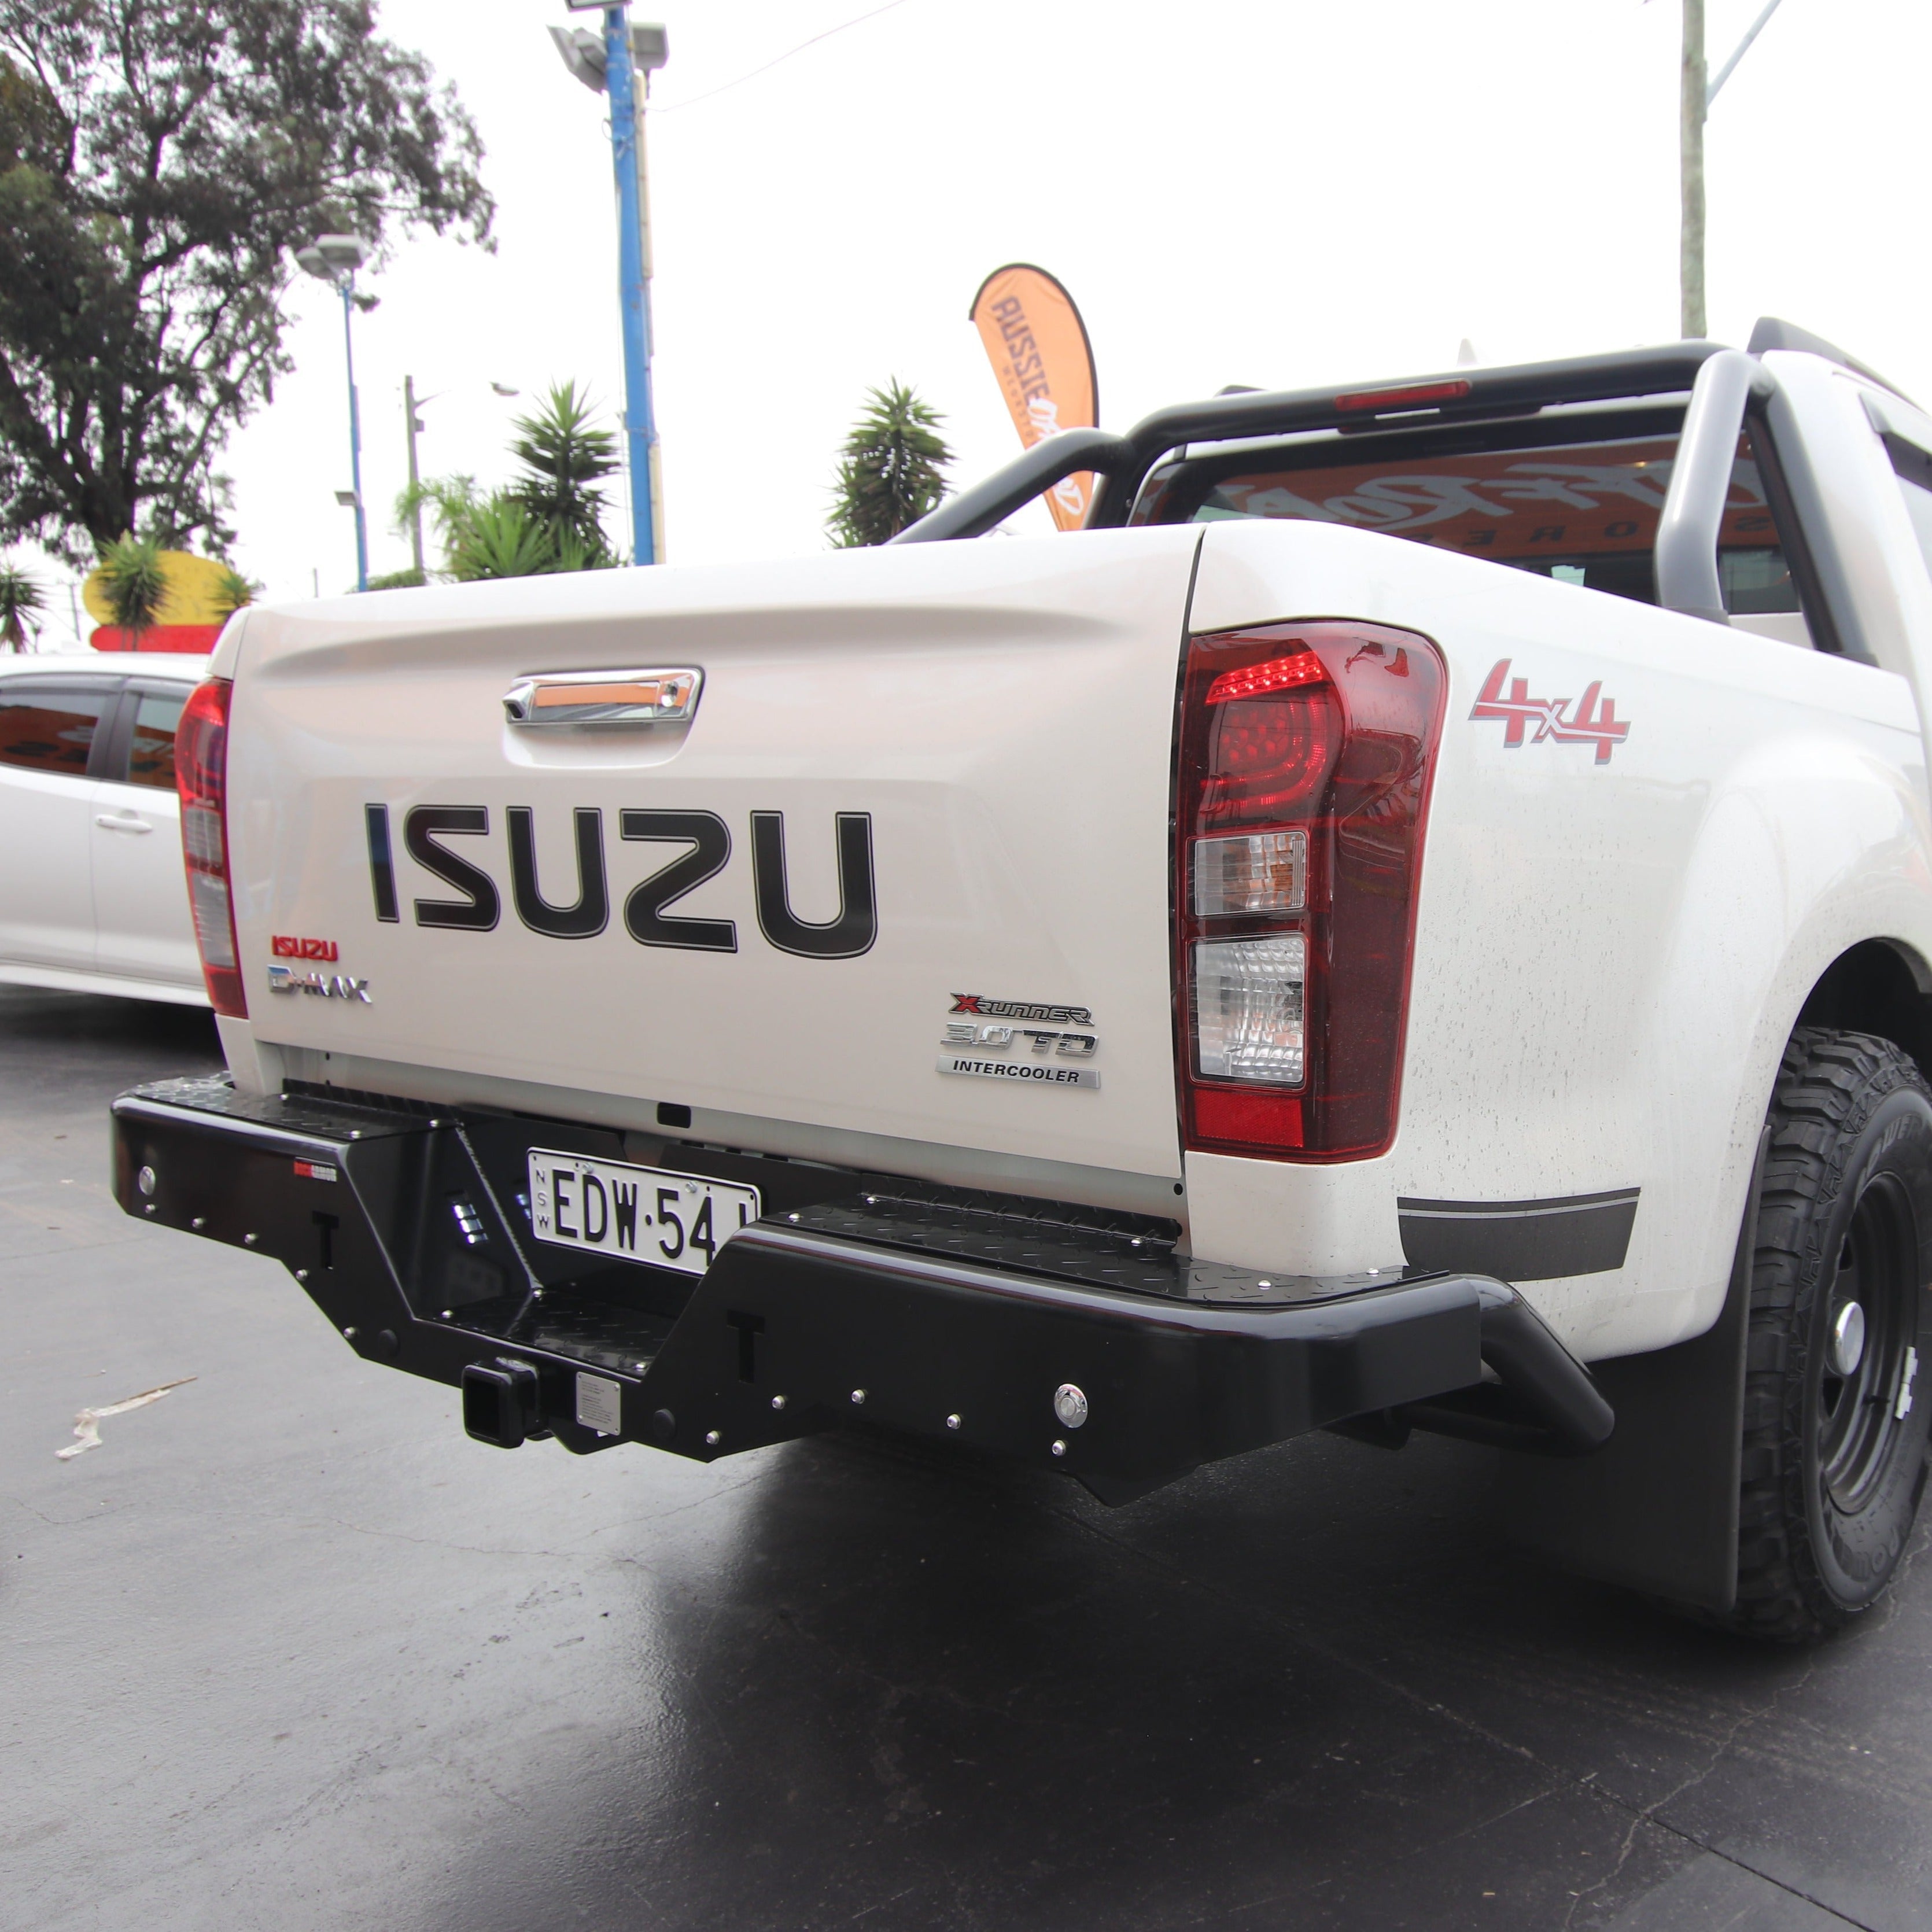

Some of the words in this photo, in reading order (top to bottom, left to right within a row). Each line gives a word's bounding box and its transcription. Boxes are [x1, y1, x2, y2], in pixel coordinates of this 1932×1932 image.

[991, 295, 1050, 408] AUSSIE
[364, 803, 878, 960] ISUZU
[272, 935, 338, 961] ISUZU
[953, 1060, 1079, 1083] INTERCOOLER
